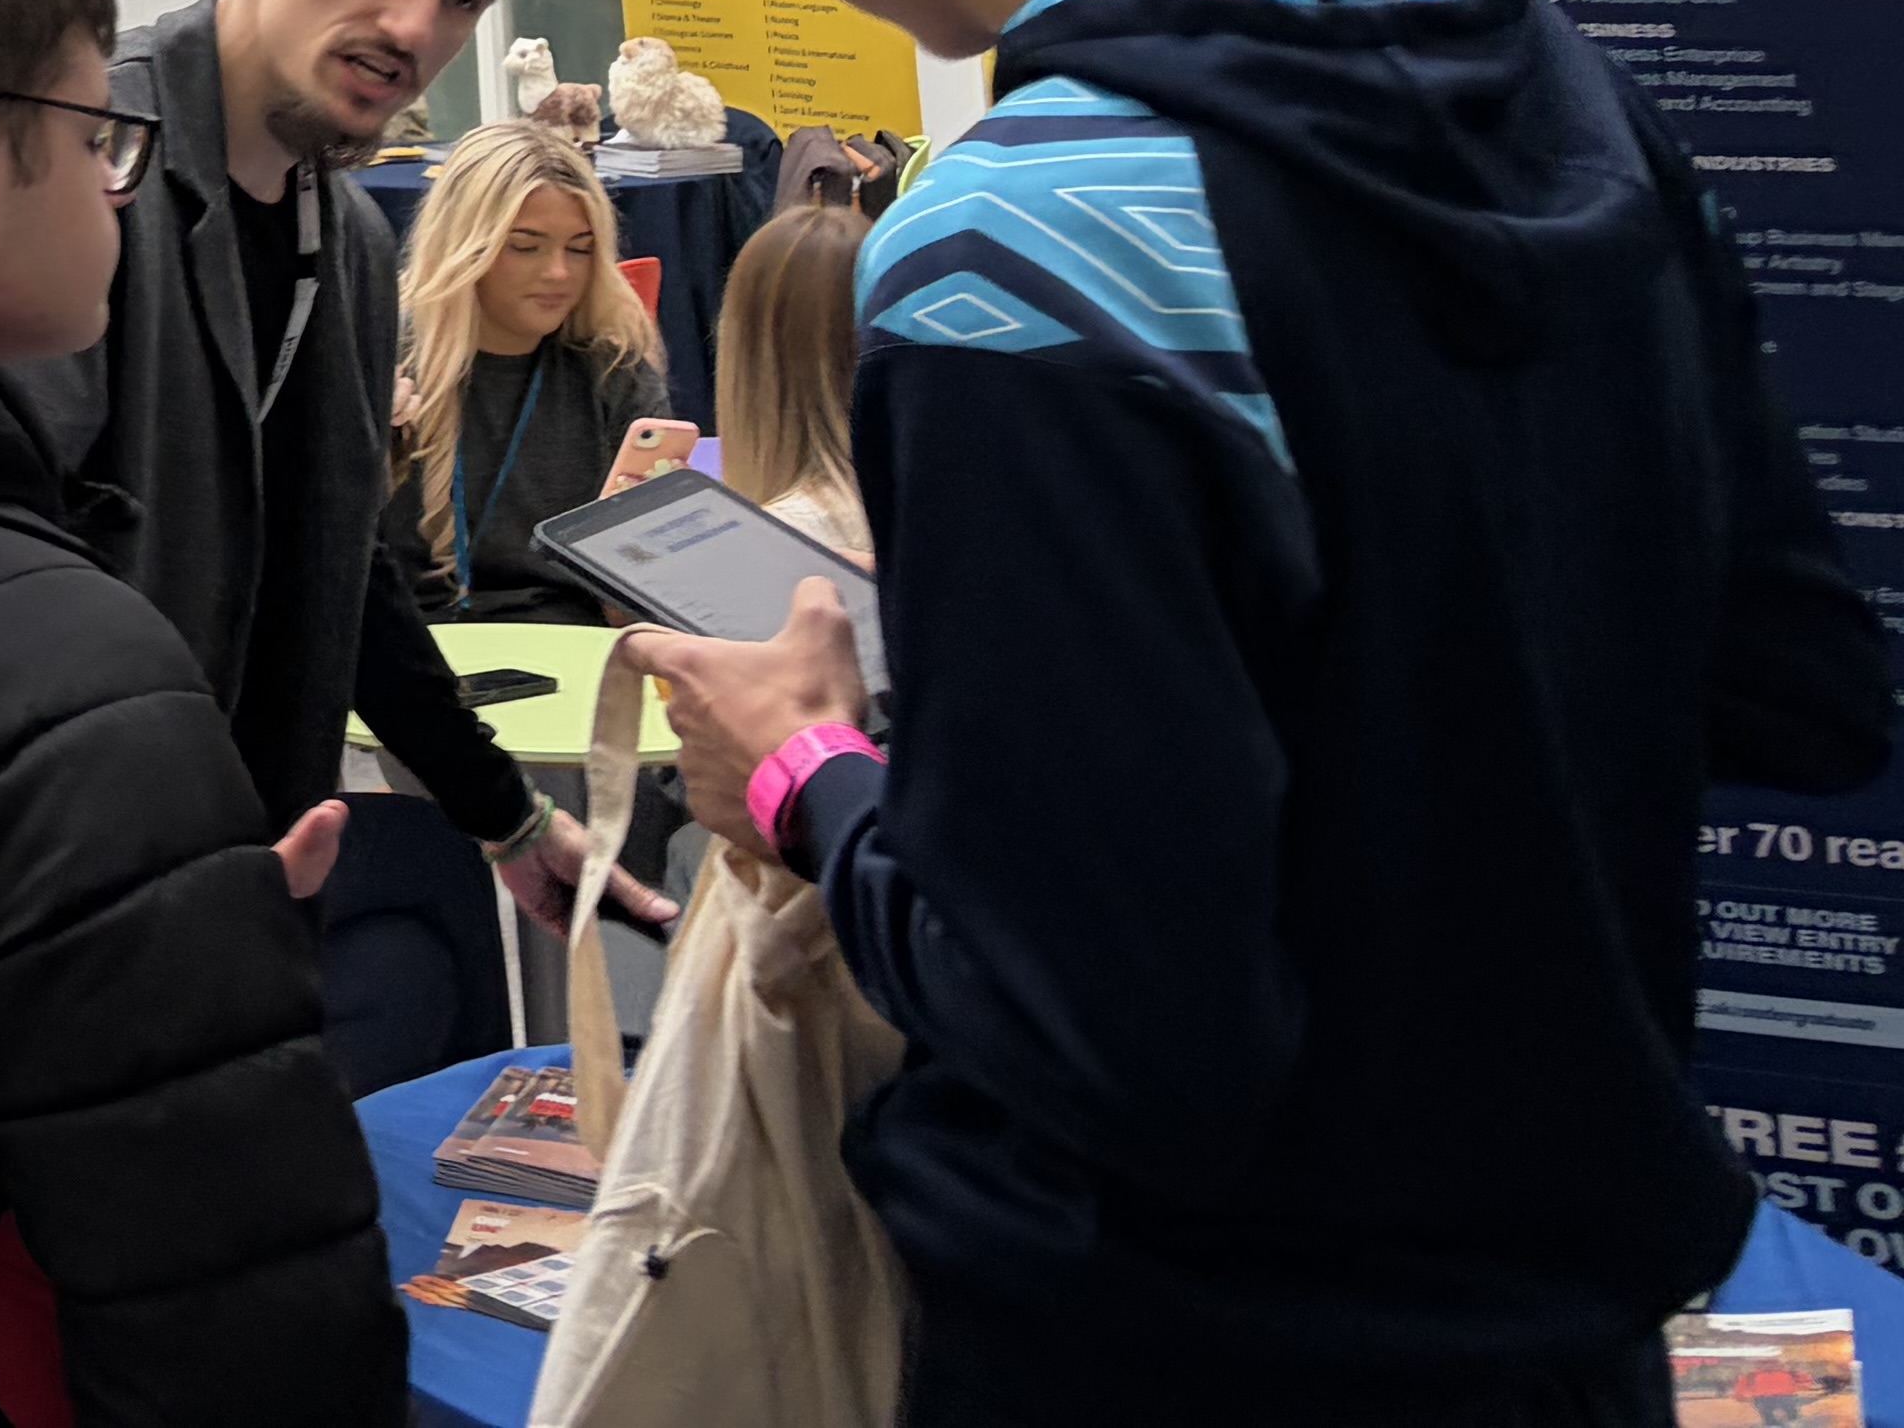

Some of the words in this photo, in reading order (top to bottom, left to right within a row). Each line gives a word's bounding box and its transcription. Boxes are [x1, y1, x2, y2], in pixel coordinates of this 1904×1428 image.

[1746, 822, 1813, 861] 70
[1826, 836, 1904, 869] rea
[1716, 901, 1781, 922] OUT
[1785, 906, 1879, 932] MORE
[1709, 920, 1790, 945] VIEW
[1795, 929, 1900, 955] ENTRY
